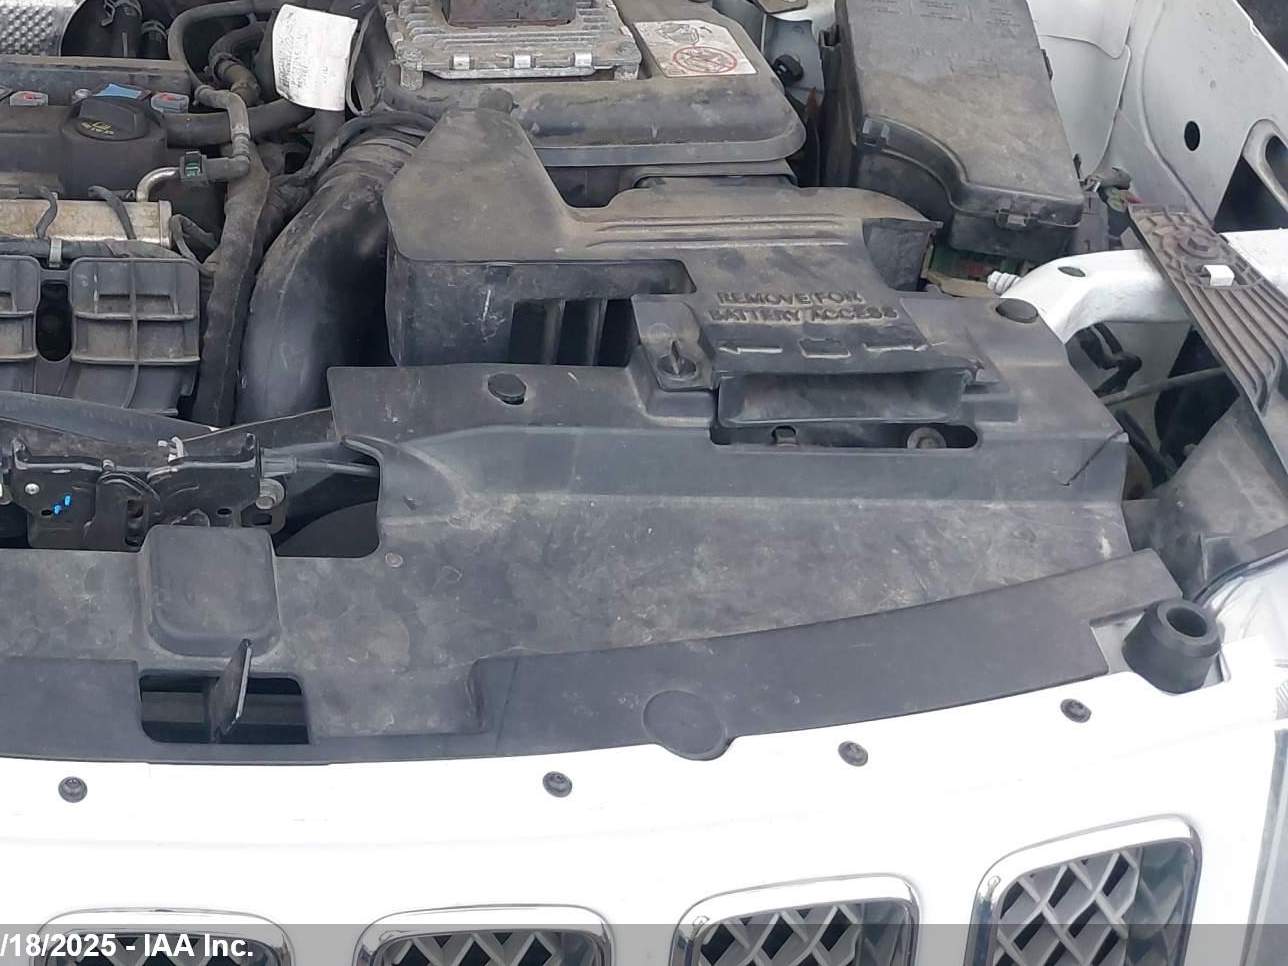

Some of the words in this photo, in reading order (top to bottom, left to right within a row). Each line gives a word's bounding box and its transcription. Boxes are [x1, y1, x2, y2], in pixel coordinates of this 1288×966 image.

[716, 291, 810, 305] REMOVE
[813, 291, 863, 304] FOR
[710, 305, 801, 322] BATTERY
[810, 306, 898, 320] ACCESS
